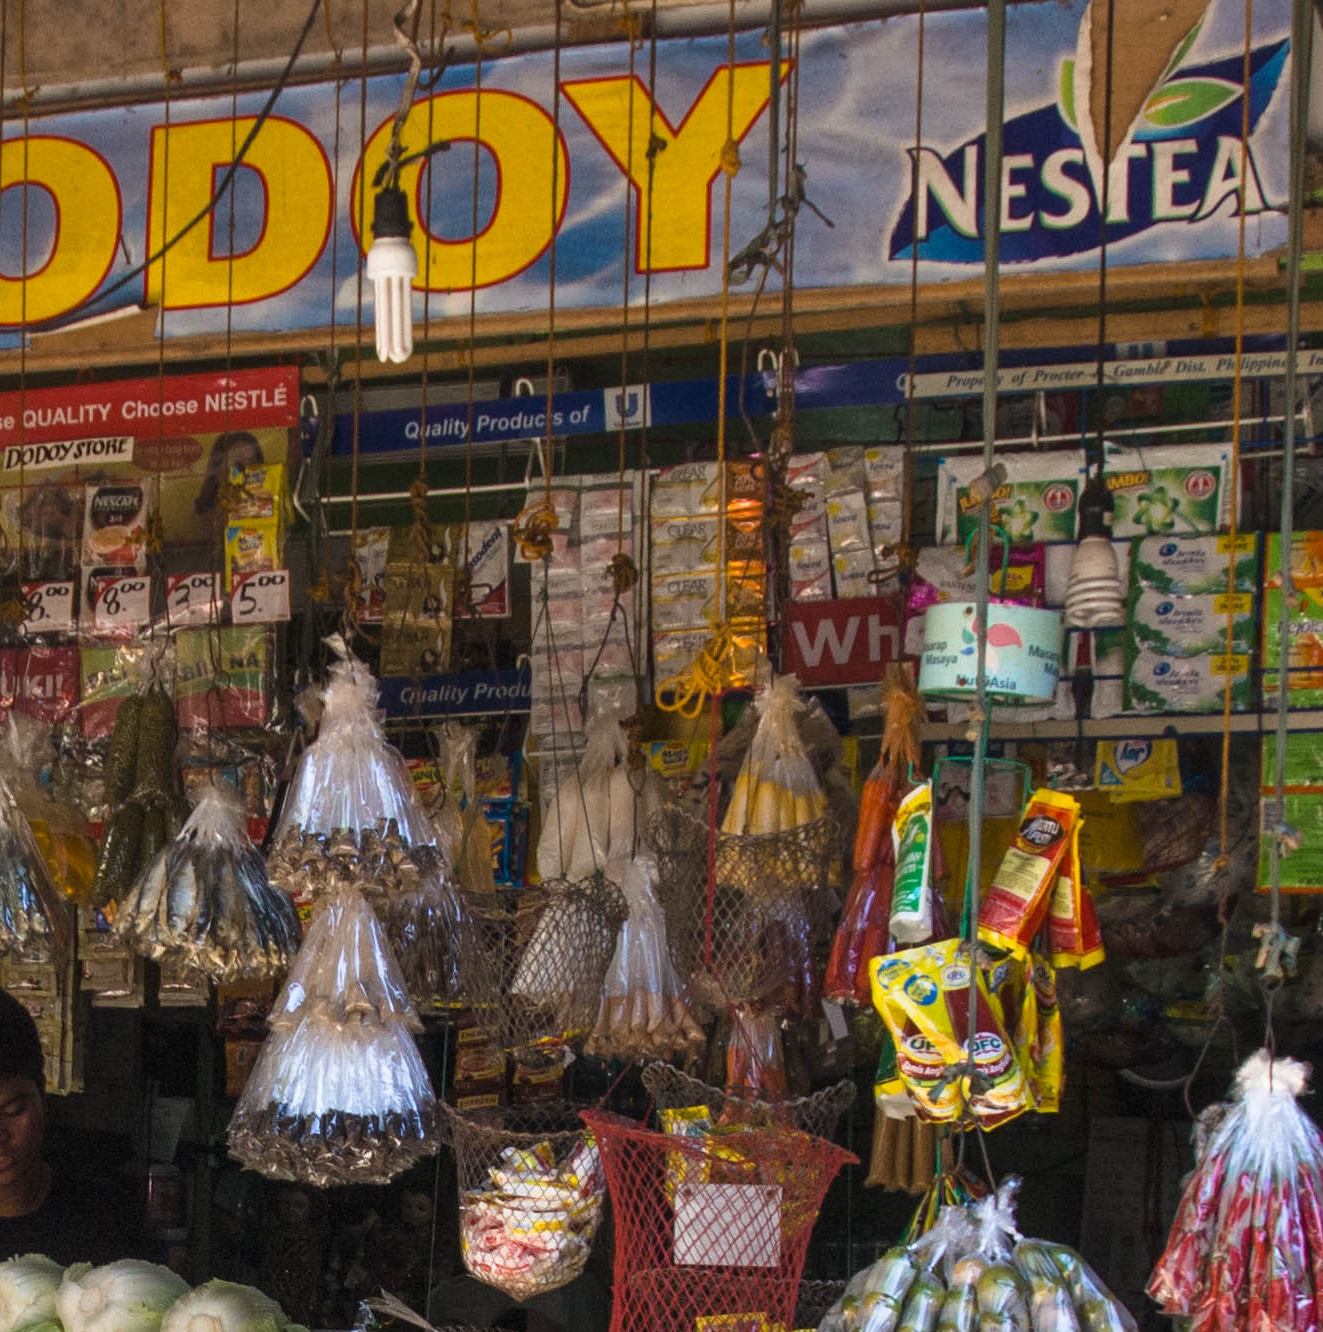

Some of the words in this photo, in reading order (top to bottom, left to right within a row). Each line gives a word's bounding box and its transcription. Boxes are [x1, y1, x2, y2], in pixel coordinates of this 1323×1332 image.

[906, 136, 1271, 241] NESTEA
[22, 403, 112, 430] QUALITY
[121, 397, 199, 421] Choose
[204, 383, 288, 412] NESTLÉ
[403, 415, 471, 441] Quality
[476, 409, 565, 434] Producs
[567, 406, 591, 426] of
[4, 441, 74, 471] DODOY
[400, 683, 470, 706] Quality
